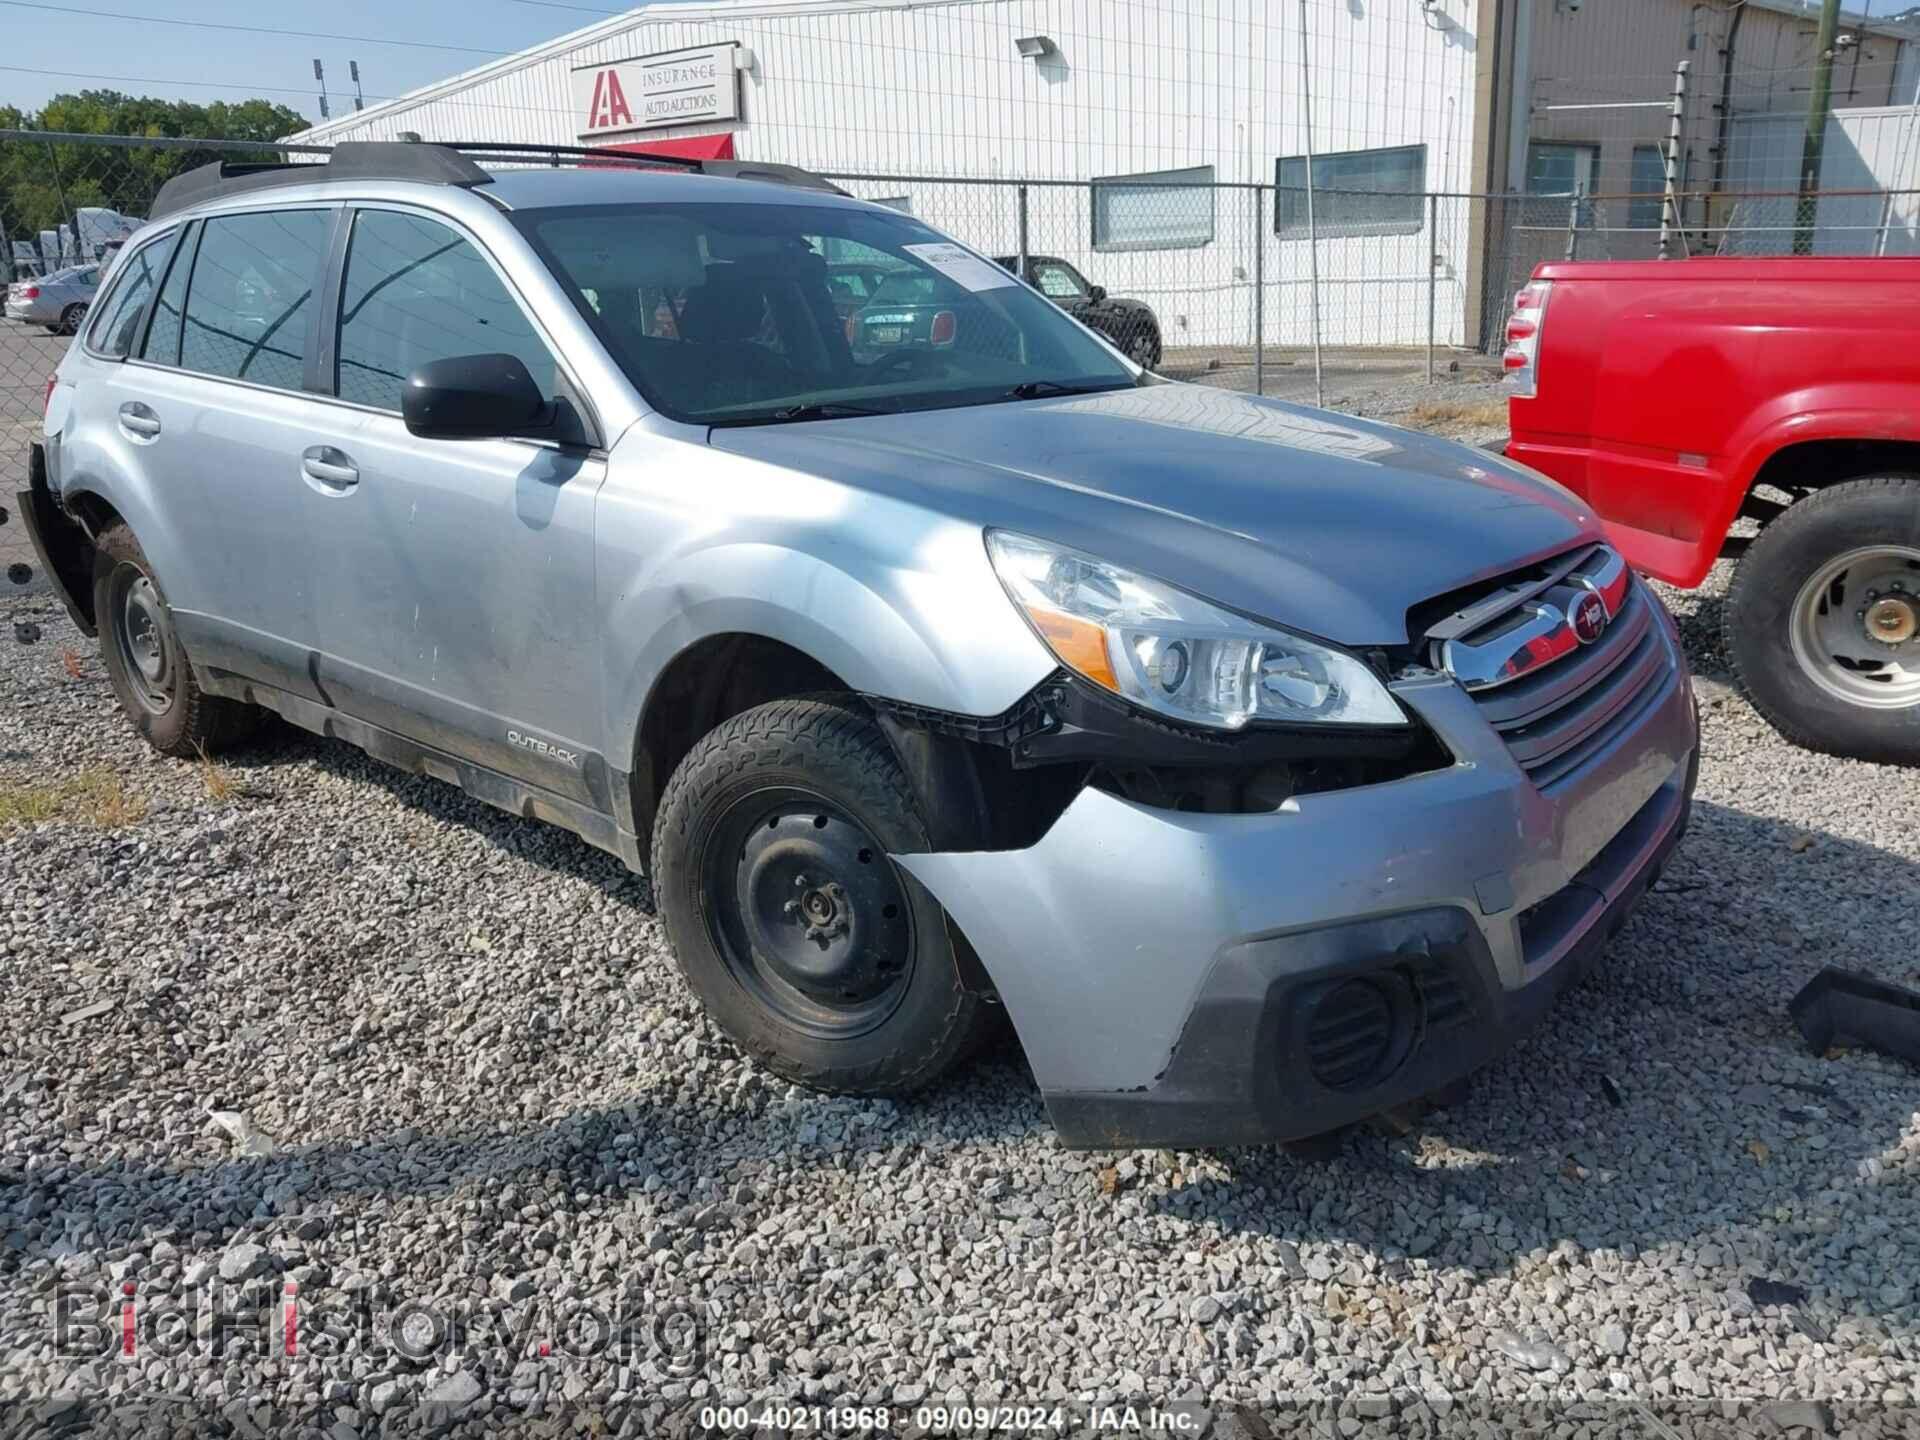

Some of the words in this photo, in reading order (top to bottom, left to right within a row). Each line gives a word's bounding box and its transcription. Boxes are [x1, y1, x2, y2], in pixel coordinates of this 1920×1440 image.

[643, 64, 716, 87] INSURANCE
[646, 99, 669, 115] AUTO
[669, 94, 717, 112] AUCTIONS
[507, 730, 578, 769] OUTBACK
